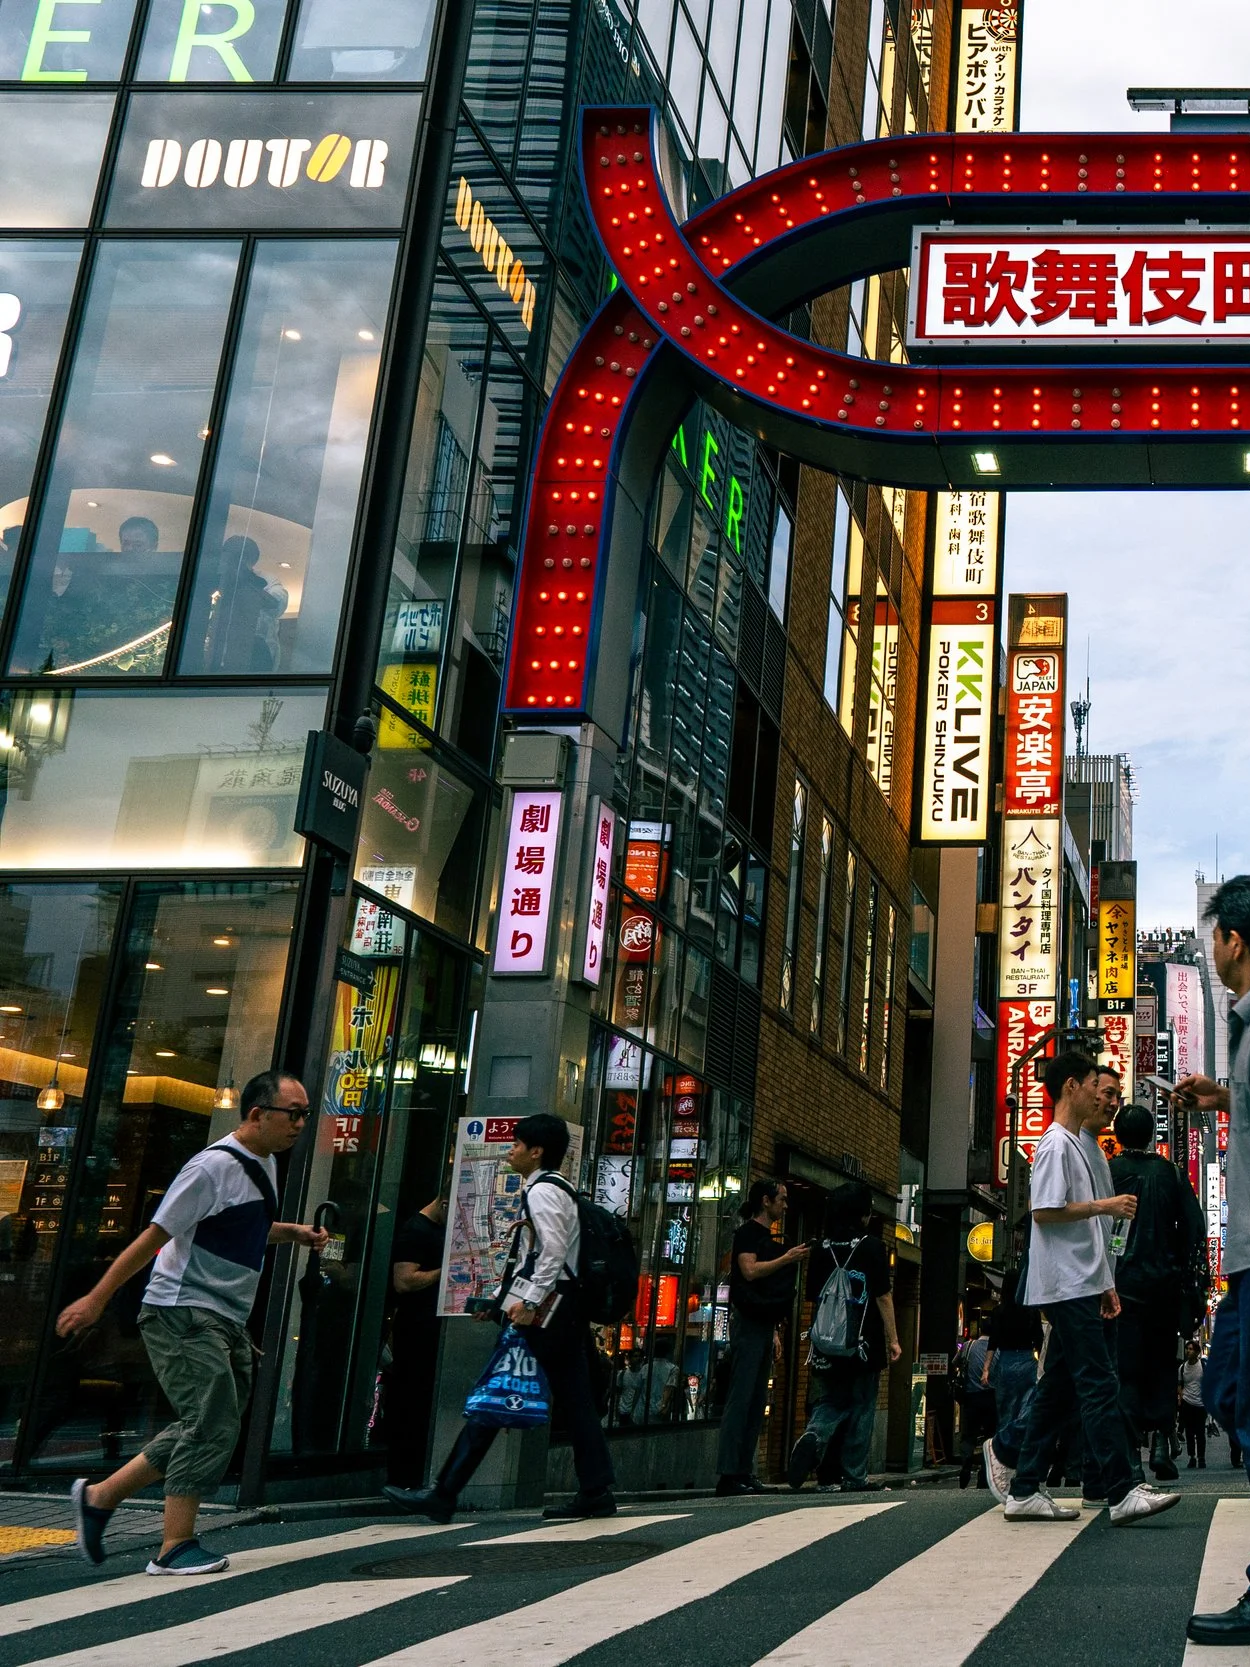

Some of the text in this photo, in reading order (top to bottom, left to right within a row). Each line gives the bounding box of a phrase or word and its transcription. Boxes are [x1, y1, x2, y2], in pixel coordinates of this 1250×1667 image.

[964, 23, 989, 128] ビアポンバー
[141, 133, 388, 188] DOUTOR
[455, 176, 536, 332] DOUTOR
[976, 603, 988, 621] 3
[1017, 680, 1056, 692] JAPAN
[932, 642, 951, 823] POKER SHINJUKU
[952, 641, 984, 822] KKLIVE
[1016, 696, 1053, 804] 安楽亭
[323, 770, 358, 808] SUZUYA
[1043, 803, 1058, 814] 2F
[509, 805, 551, 958] 劇場通り
[587, 817, 612, 968] 劇場通り
[1010, 867, 1037, 961] バンタイ
[1040, 868, 1052, 954] タイ国料理専門店
[1017, 984, 1037, 994] 3F
[1104, 922, 1119, 994] ヤマネ肉店
[1035, 1006, 1051, 1017] 2F
[1107, 1000, 1125, 1010] B1F
[1006, 1007, 1026, 1131] ANRAKUEI
[488, 1375, 541, 1394] store
[492, 1346, 538, 1376] BYU
